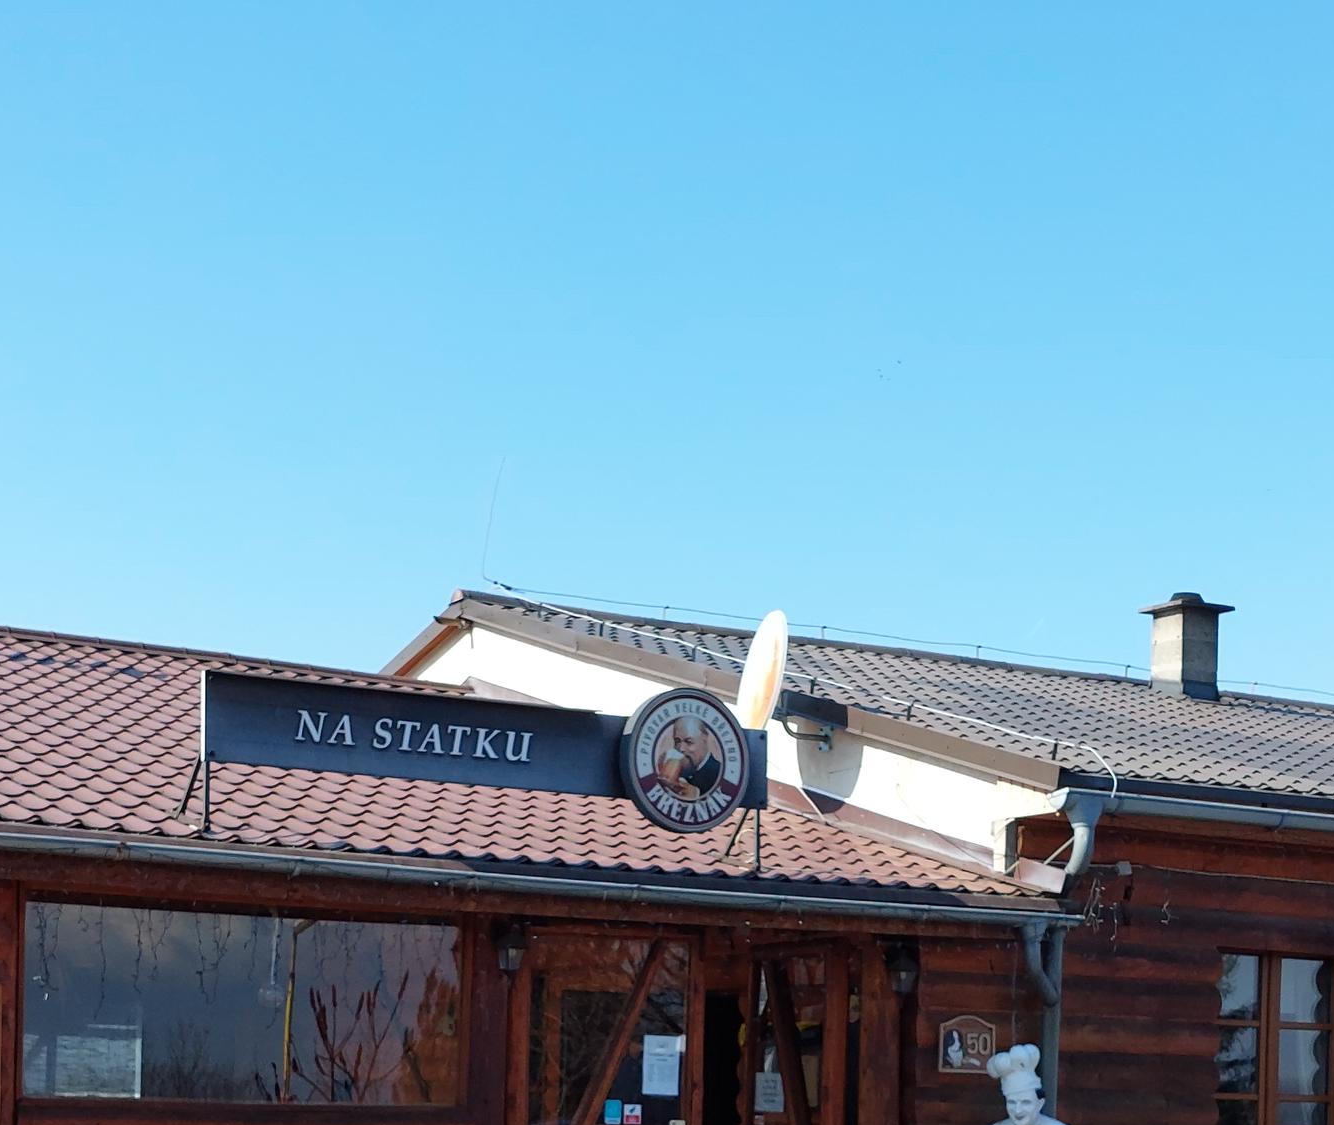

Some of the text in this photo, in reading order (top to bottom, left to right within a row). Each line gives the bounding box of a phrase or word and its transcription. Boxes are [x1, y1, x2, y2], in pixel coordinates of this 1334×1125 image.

[295, 709, 534, 762] NA STATKU
[640, 707, 671, 755] PIVOVAR
[967, 1032, 991, 1056] 50
